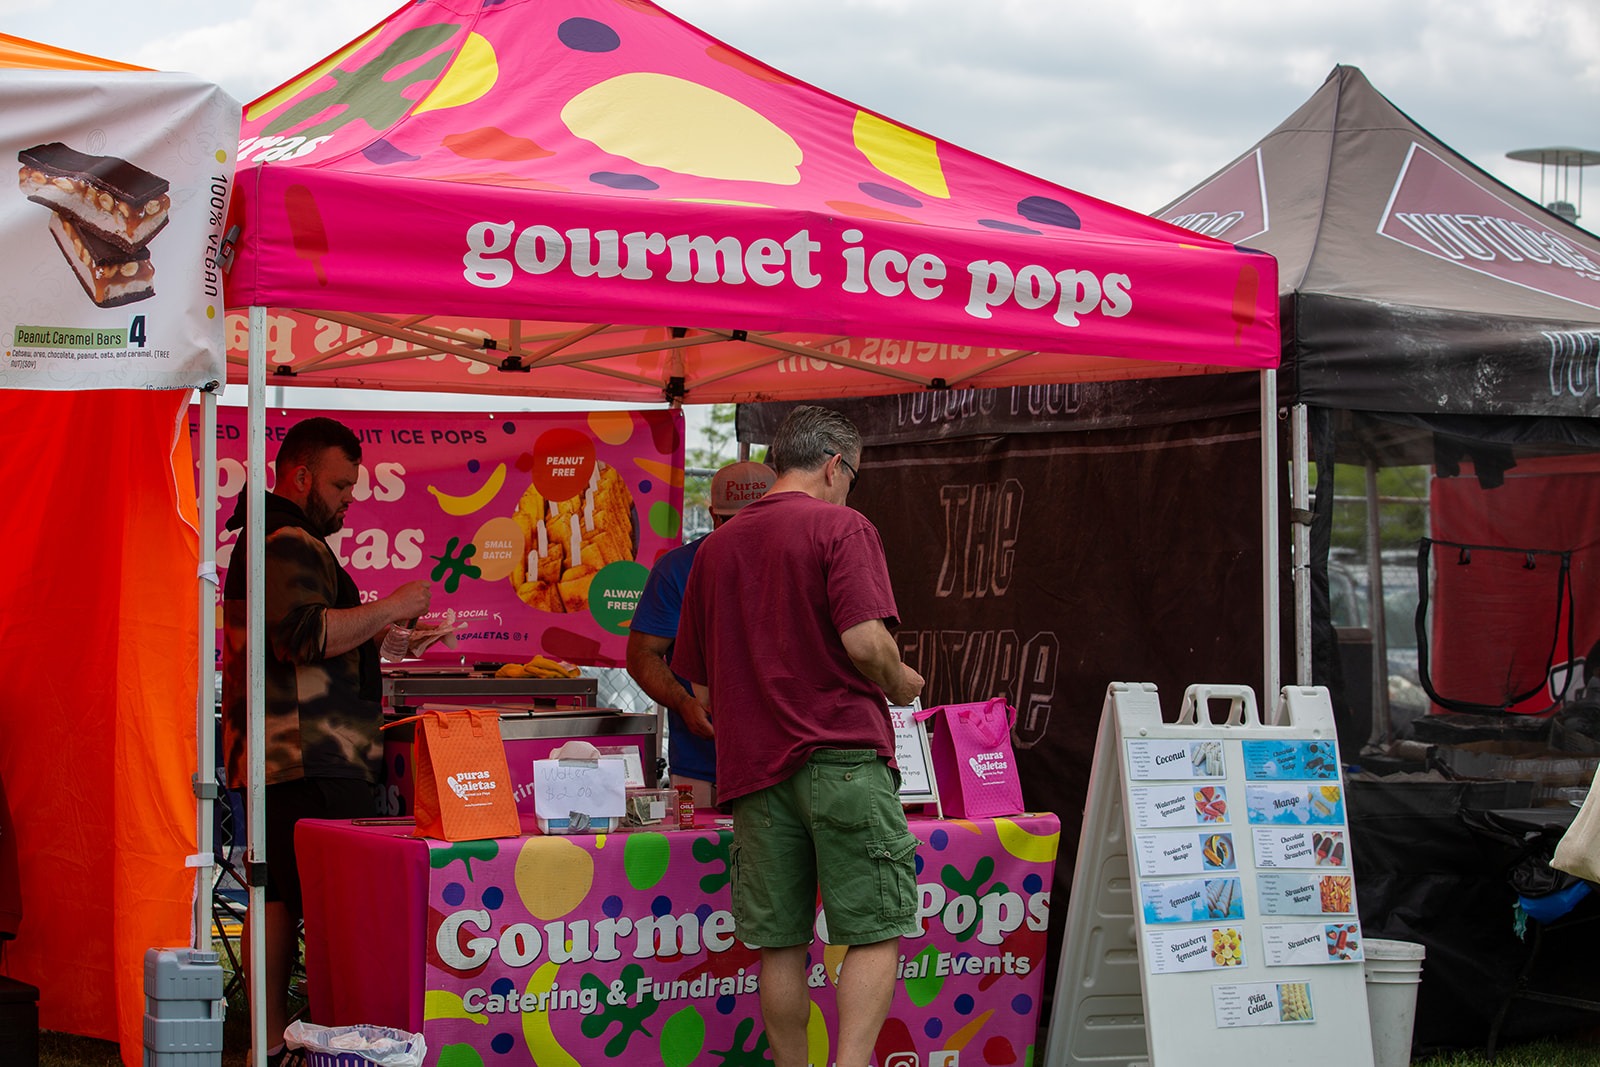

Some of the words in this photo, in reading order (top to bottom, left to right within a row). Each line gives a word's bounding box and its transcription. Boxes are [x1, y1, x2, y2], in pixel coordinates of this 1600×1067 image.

[209, 174, 228, 226] 100%
[463, 220, 821, 289] gourmet
[842, 229, 946, 300] ice
[964, 260, 1132, 327] pops
[18, 330, 51, 344] Peanut
[53, 331, 94, 346] Caramel
[97, 333, 122, 346] Bars
[129, 315, 147, 348] 4
[116, 349, 128, 358] and
[391, 430, 425, 444] ICE
[431, 430, 487, 444] POPS
[546, 456, 585, 466] PEANUT
[552, 468, 576, 477] FREE
[726, 480, 767, 491] Puras
[484, 540, 513, 549] SMALL
[482, 551, 513, 560] BATCH
[457, 609, 489, 618] SOCIAL
[976, 751, 1004, 763] puras
[1155, 749, 1186, 765] Coconut
[975, 761, 1008, 774] paletas
[456, 770, 491, 783] puras
[455, 781, 497, 794] paletas
[1273, 796, 1300, 810] Mango
[1280, 833, 1305, 844] Chocolate
[1284, 884, 1315, 897] Strawberry
[1169, 890, 1201, 908] Lemonade
[436, 909, 764, 970] Gourme
[1170, 934, 1207, 952] Strawberry
[1288, 934, 1321, 950] Strawberry
[1175, 945, 1208, 962] Lemonade
[462, 983, 597, 1015] Catering
[606, 979, 628, 1006] &
[807, 963, 827, 988] &
[935, 952, 1031, 977] Events
[1247, 993, 1267, 1005] Piña
[1247, 1000, 1273, 1015] Colada
